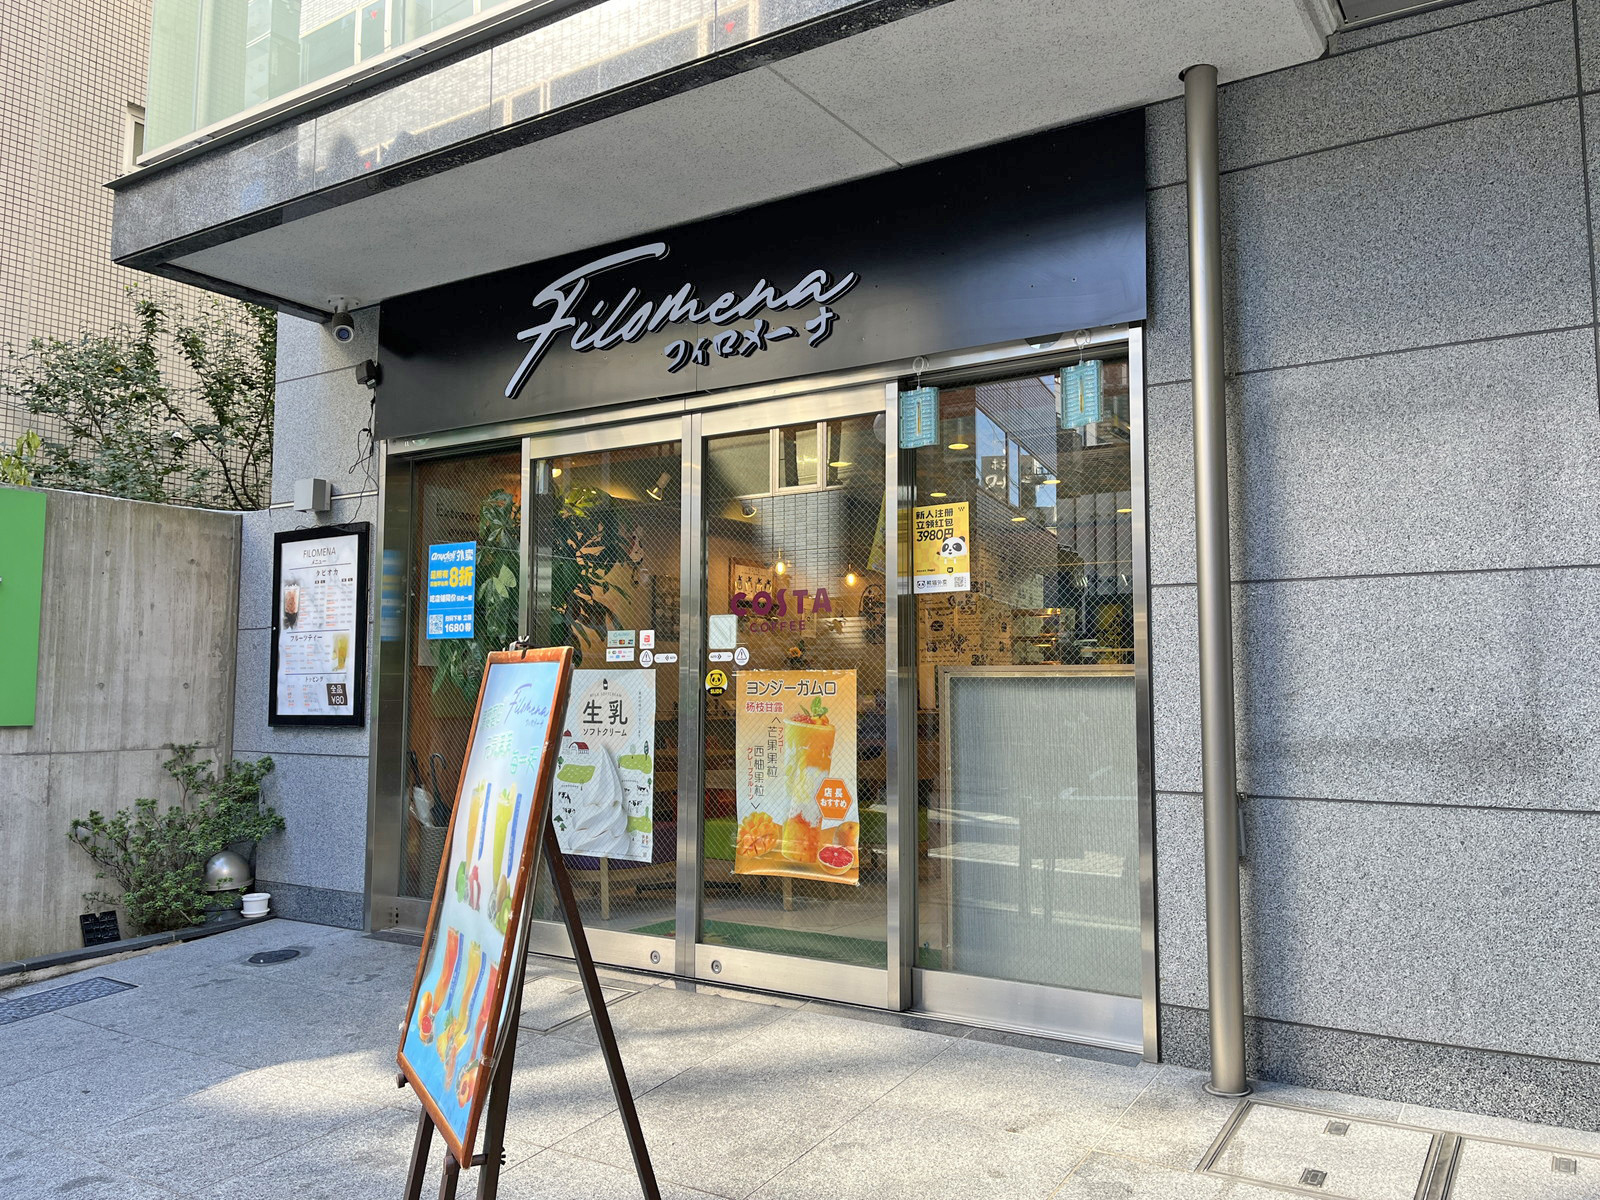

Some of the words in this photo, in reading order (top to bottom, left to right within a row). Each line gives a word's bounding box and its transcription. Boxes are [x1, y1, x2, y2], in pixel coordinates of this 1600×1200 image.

[504, 242, 857, 399] Filomena
[915, 508, 954, 519] 新人注册
[915, 518, 954, 530] 立领红包
[303, 547, 336, 558] FILOMENA
[316, 568, 339, 577] タピオカ
[449, 565, 474, 587] 8折
[730, 588, 832, 617] COSTA
[750, 620, 806, 633] COFFEE
[290, 634, 323, 642] フルーツティー
[330, 684, 343, 694] 全品
[746, 679, 837, 697] ヨンジーガムロ
[331, 695, 345, 705] ¥80
[583, 699, 628, 725] 生乳
[746, 702, 784, 713] 杨枝甘露
[583, 728, 627, 737] ソフトクリーム
[767, 726, 778, 778] 芒果果粒
[754, 745, 765, 797] 西柚果粒
[824, 787, 843, 798] 店長
[820, 799, 847, 808] おすすめ
